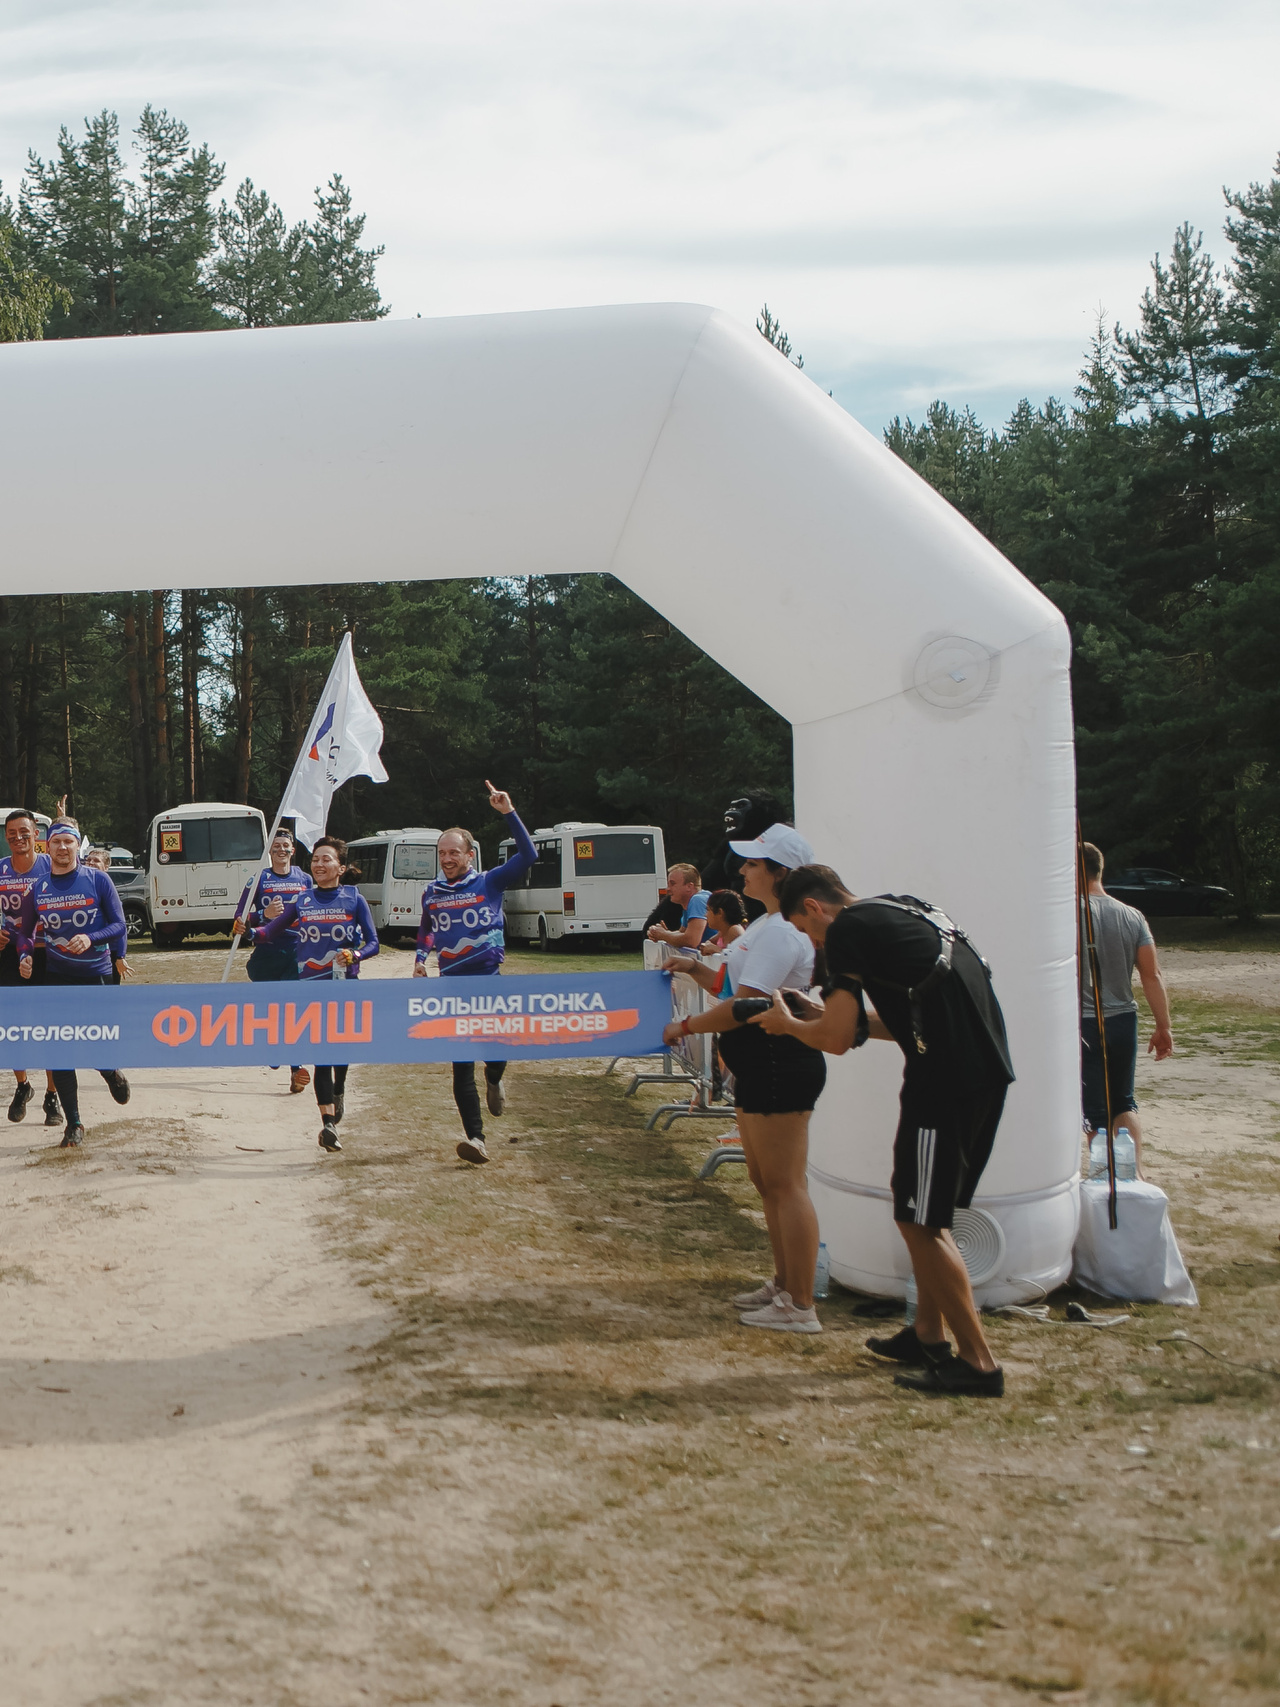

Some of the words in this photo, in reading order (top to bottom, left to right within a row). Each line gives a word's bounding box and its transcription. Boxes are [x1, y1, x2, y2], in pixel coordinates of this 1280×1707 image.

[65, 893, 86, 901] ГОНКА
[455, 892, 476, 900] ГОНКА
[66, 900, 86, 908] ГЕРОЕВ
[408, 994, 521, 1017] БОЛЬШАЯ
[526, 992, 607, 1013] ГОНКА
[151, 1000, 374, 1047] ФИНИШ
[455, 1016, 525, 1035] ВРЕМЯ
[529, 1014, 608, 1033] ГЕРОЕВ
